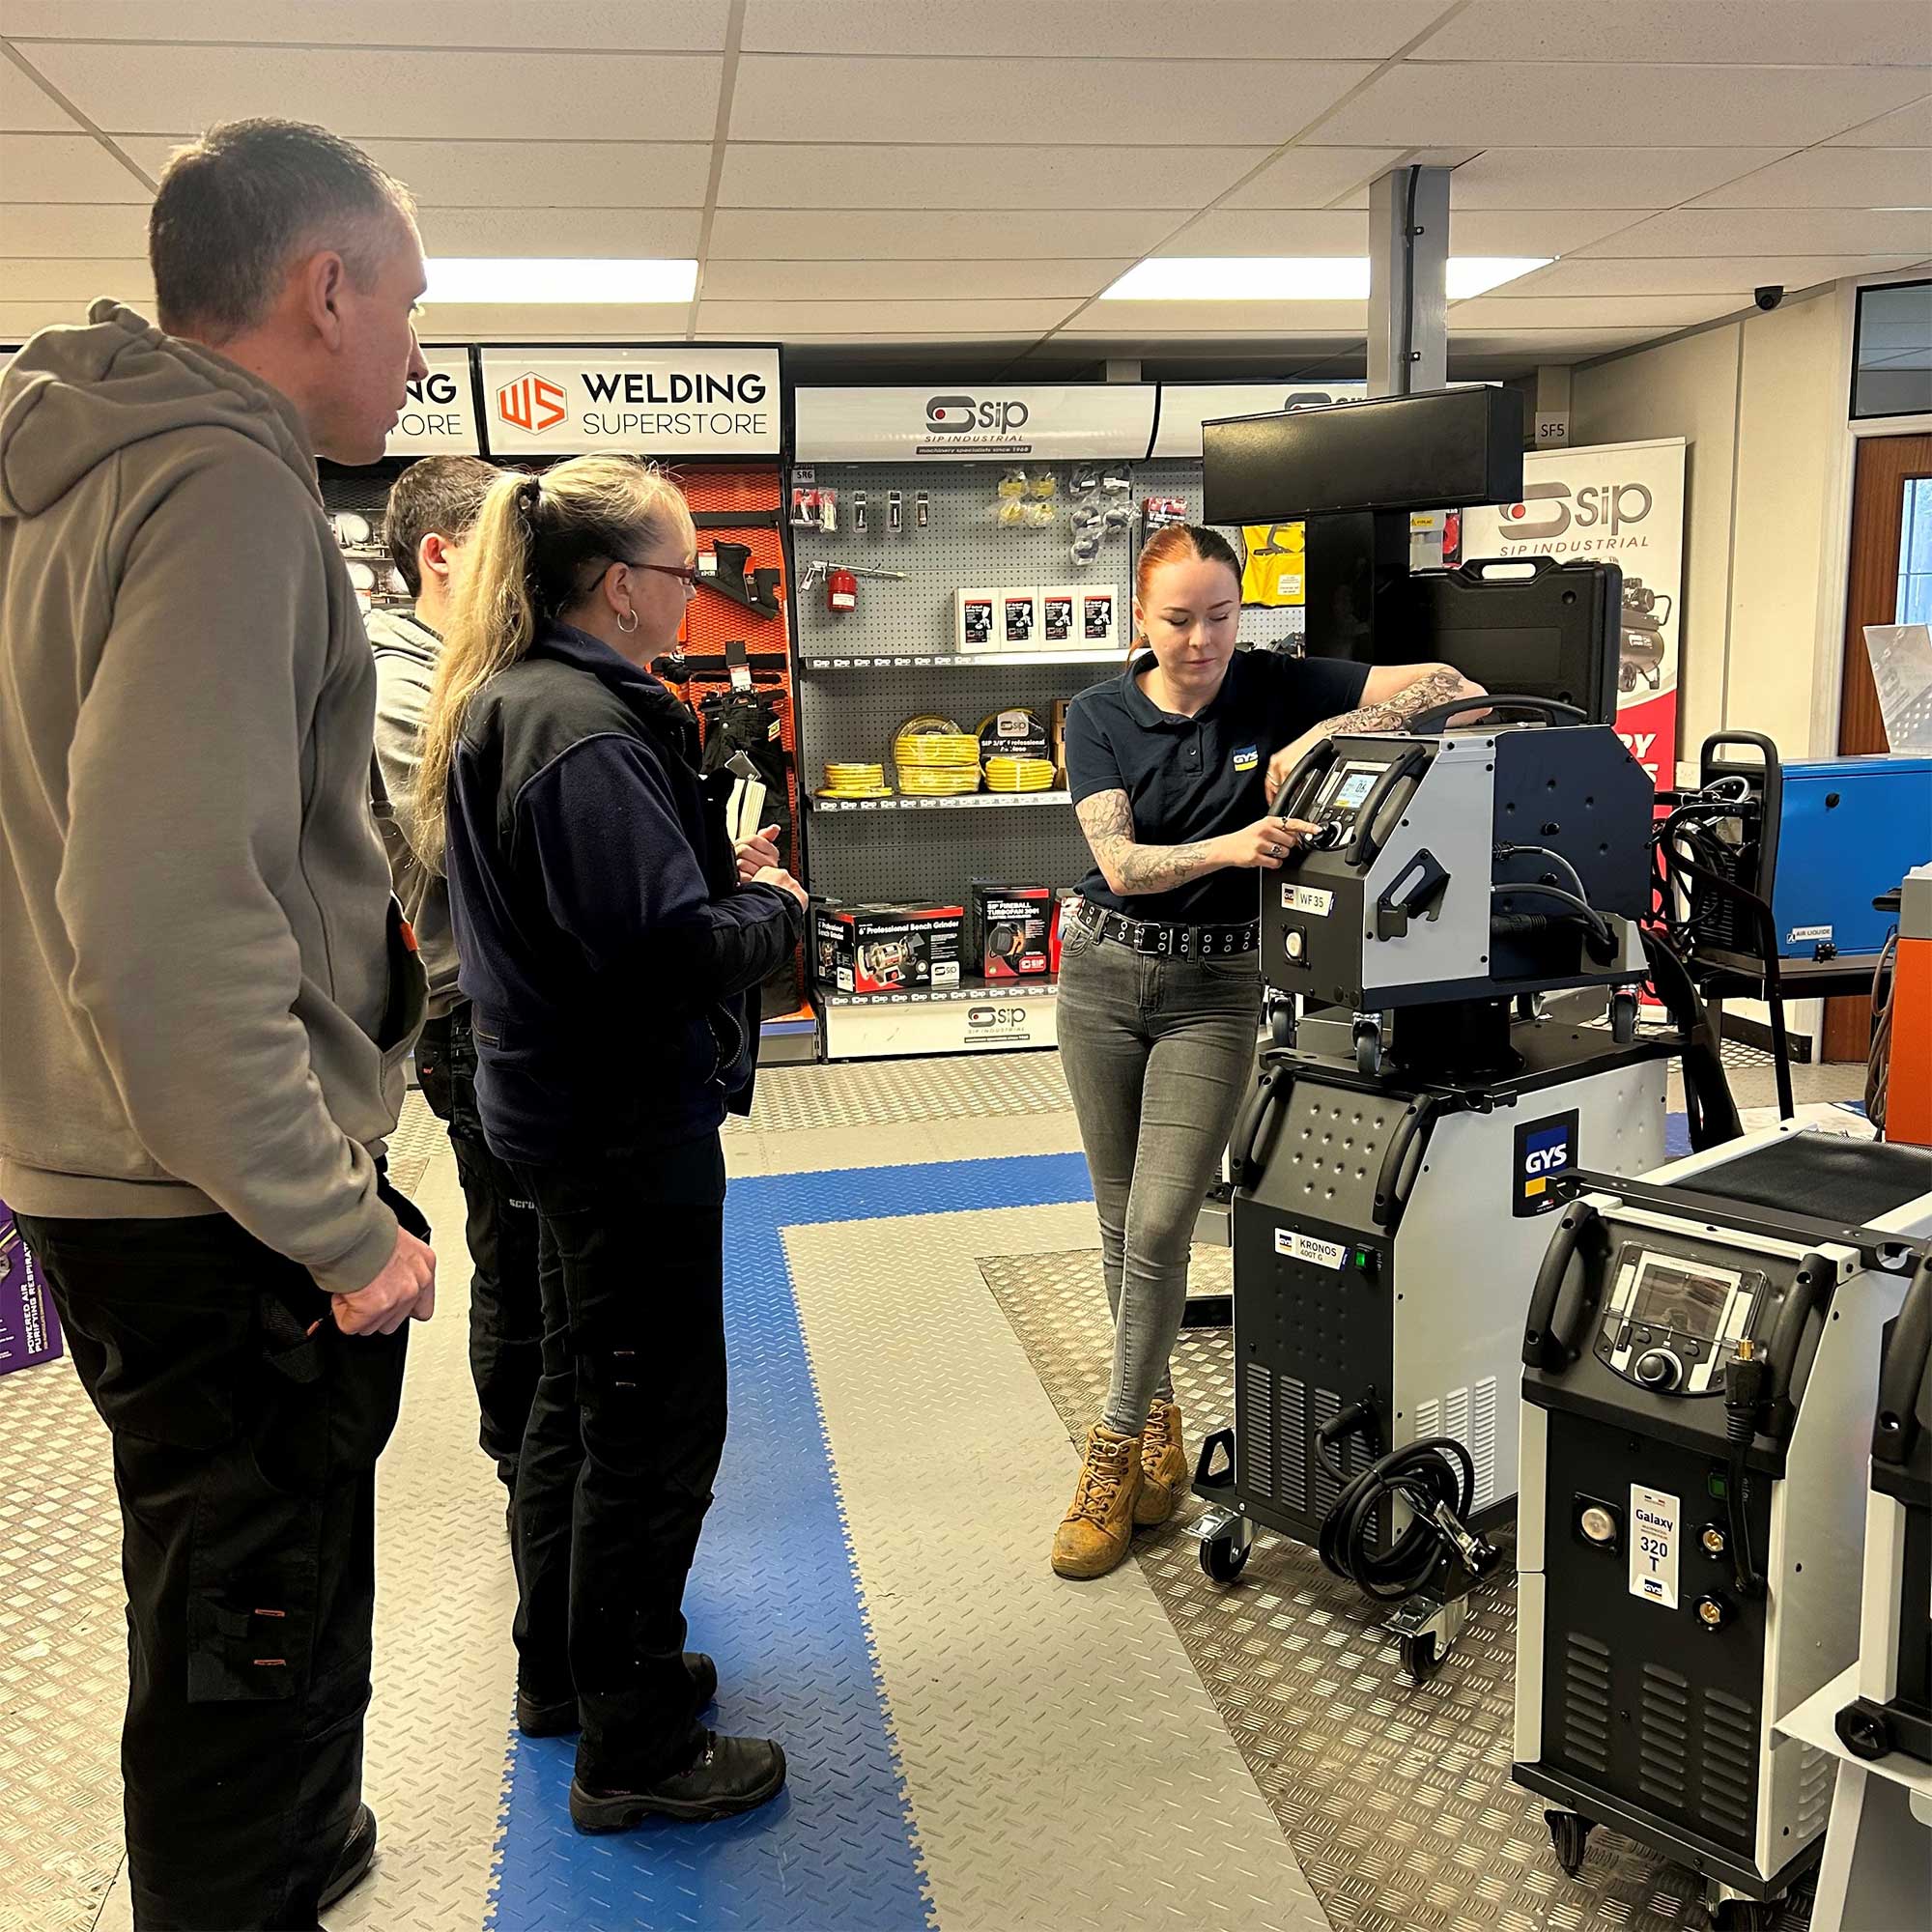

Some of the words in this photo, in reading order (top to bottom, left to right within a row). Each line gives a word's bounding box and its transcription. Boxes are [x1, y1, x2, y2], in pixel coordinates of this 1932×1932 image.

[581, 374, 766, 404] WELDING
[582, 412, 767, 435] SUPERSTORE
[978, 401, 1029, 434] sip
[1541, 424, 1565, 437] SF5
[797, 470, 813, 479] SR6
[1575, 483, 1653, 536] sip
[1500, 545, 1527, 556] SIP
[1533, 536, 1650, 554] INDUSTRIAL
[1234, 751, 1259, 763] GYS
[1300, 893, 1313, 905] WF
[1314, 895, 1324, 908] 35
[866, 923, 909, 935] Professional
[910, 922, 932, 931] Bench
[932, 921, 959, 929] Grinder
[998, 1008, 1026, 1027] sip
[1525, 1143, 1567, 1174] GYS
[1299, 1239, 1337, 1257] KRONOS
[1300, 1249, 1316, 1259] 400T
[20, 1284, 30, 1301] AIR
[22, 1303, 36, 1354] POWERED
[29, 1297, 43, 1352] PURIFYING
[1635, 1509, 1673, 1532] Galaxy
[1640, 1536, 1667, 1557] 320
[1649, 1555, 1660, 1573] T
